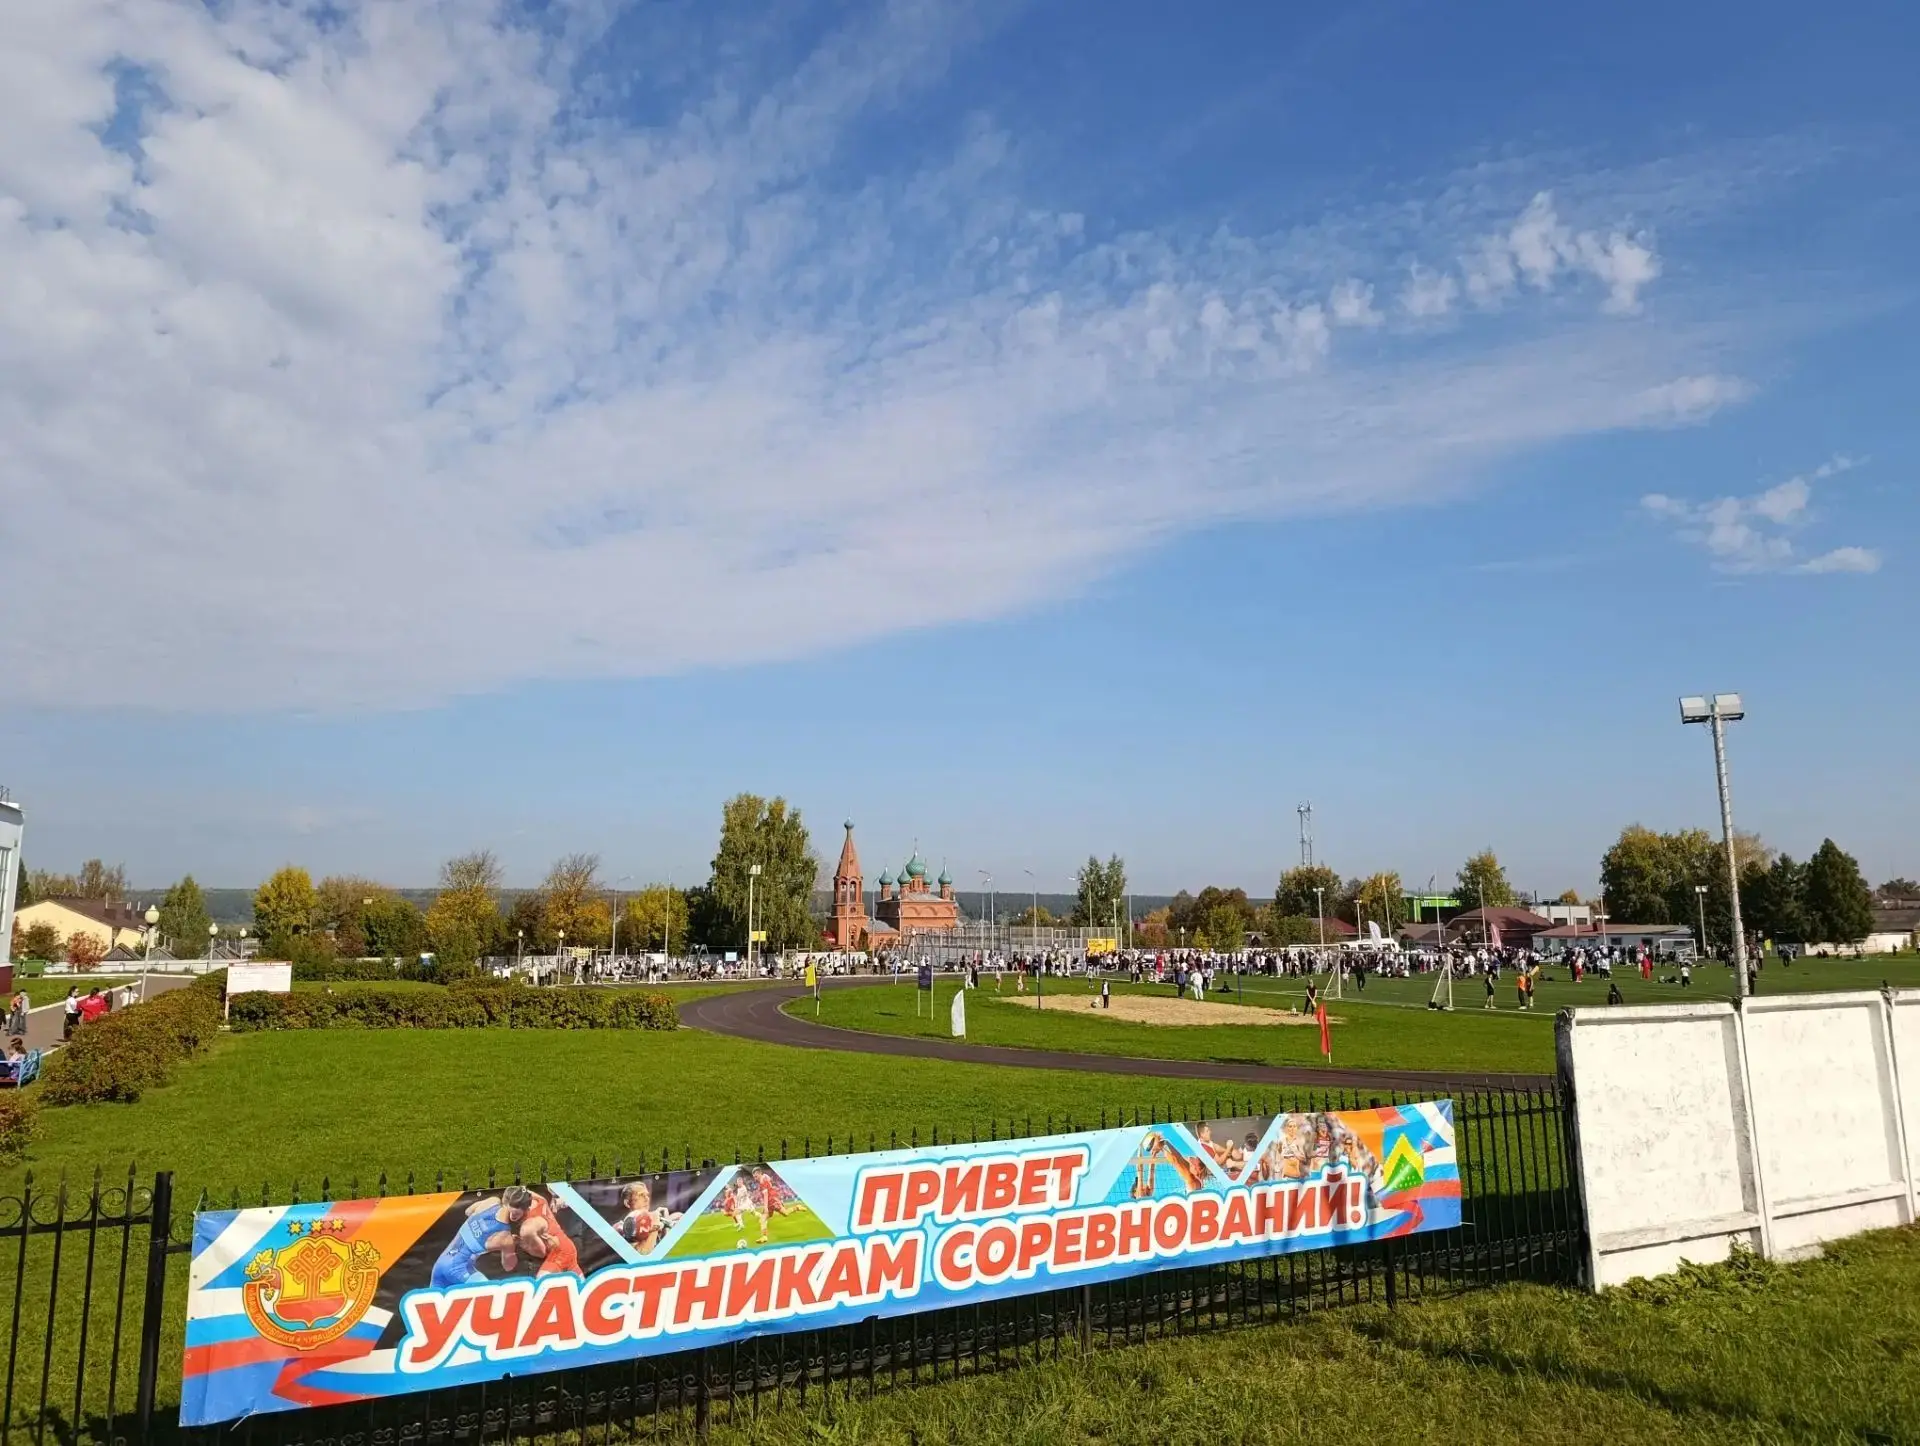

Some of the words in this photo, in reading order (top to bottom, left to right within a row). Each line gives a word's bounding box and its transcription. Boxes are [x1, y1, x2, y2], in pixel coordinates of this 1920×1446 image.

[858, 1153, 1088, 1226] ПРИВЕТ
[469, 1219, 483, 1239] RUS
[410, 1239, 918, 1363] УЧАСТНИКАМ
[940, 1171, 1362, 1282] СОРЕВНОВАНИЙ!
